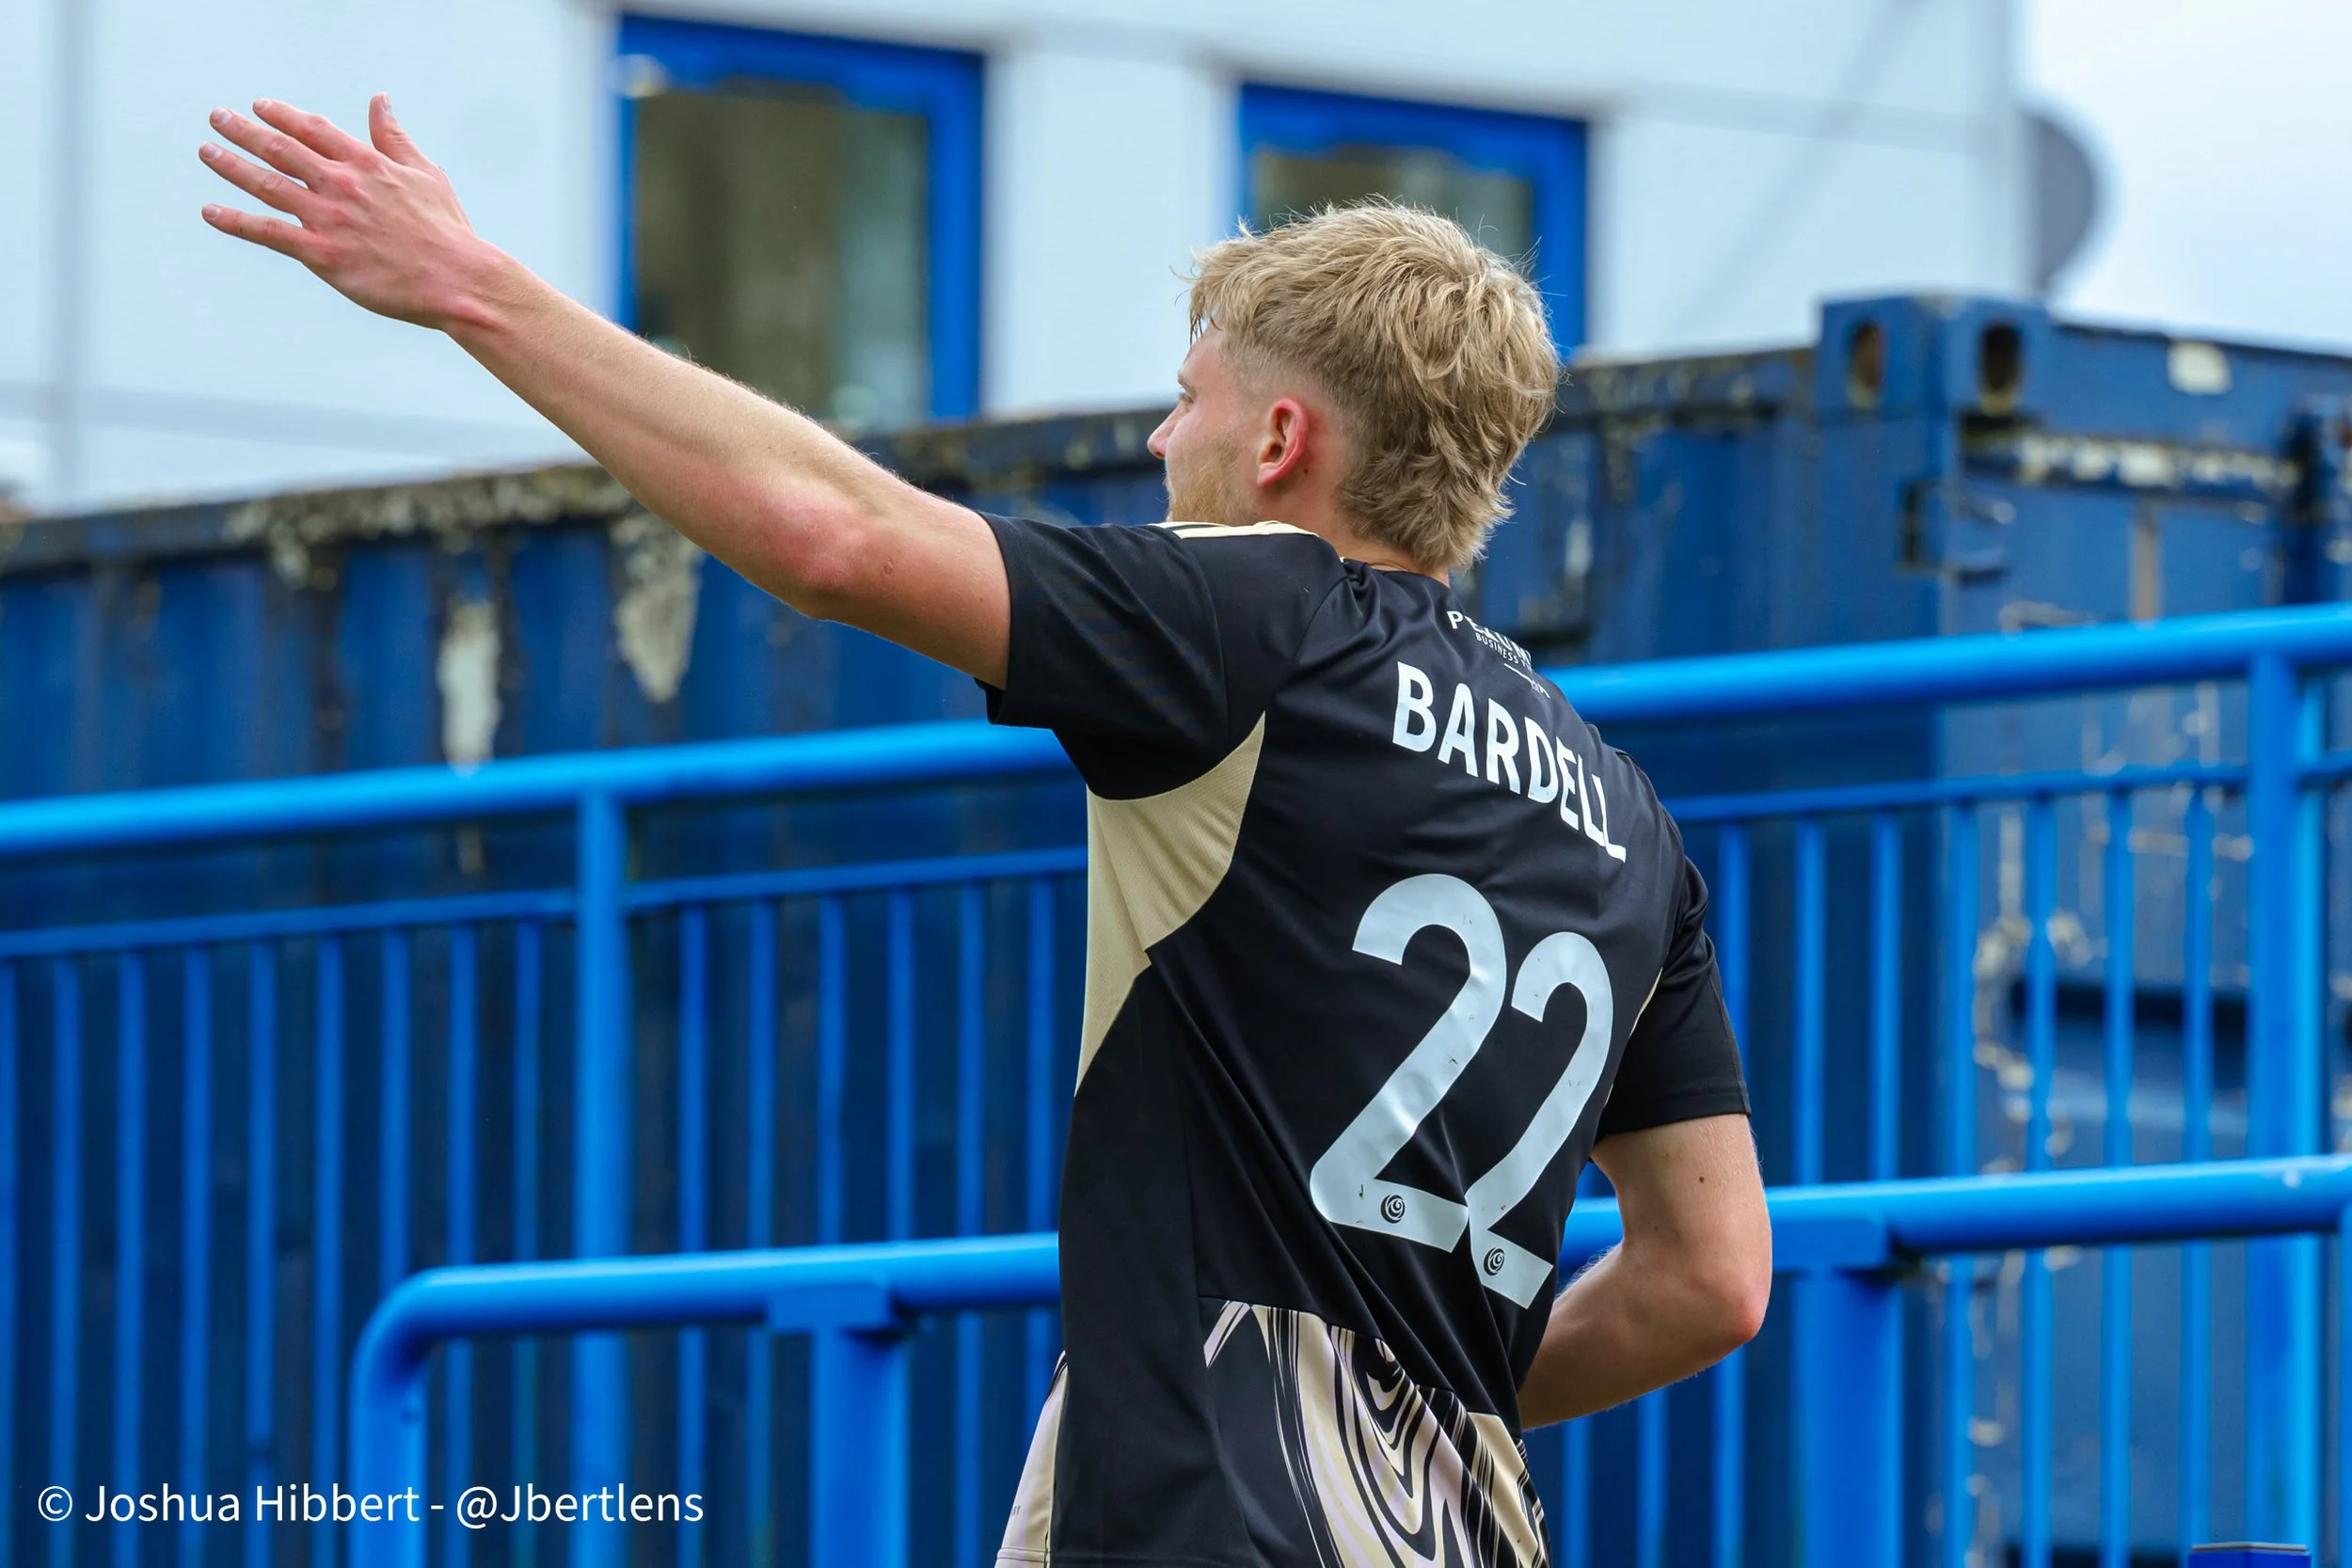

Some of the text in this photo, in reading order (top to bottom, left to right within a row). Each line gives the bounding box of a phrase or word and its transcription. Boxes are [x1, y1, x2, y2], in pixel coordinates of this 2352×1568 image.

[1474, 632, 1518, 664] BUSINESS
[1392, 661, 1626, 863] BARDELL
[1310, 873, 1614, 1309] 22
